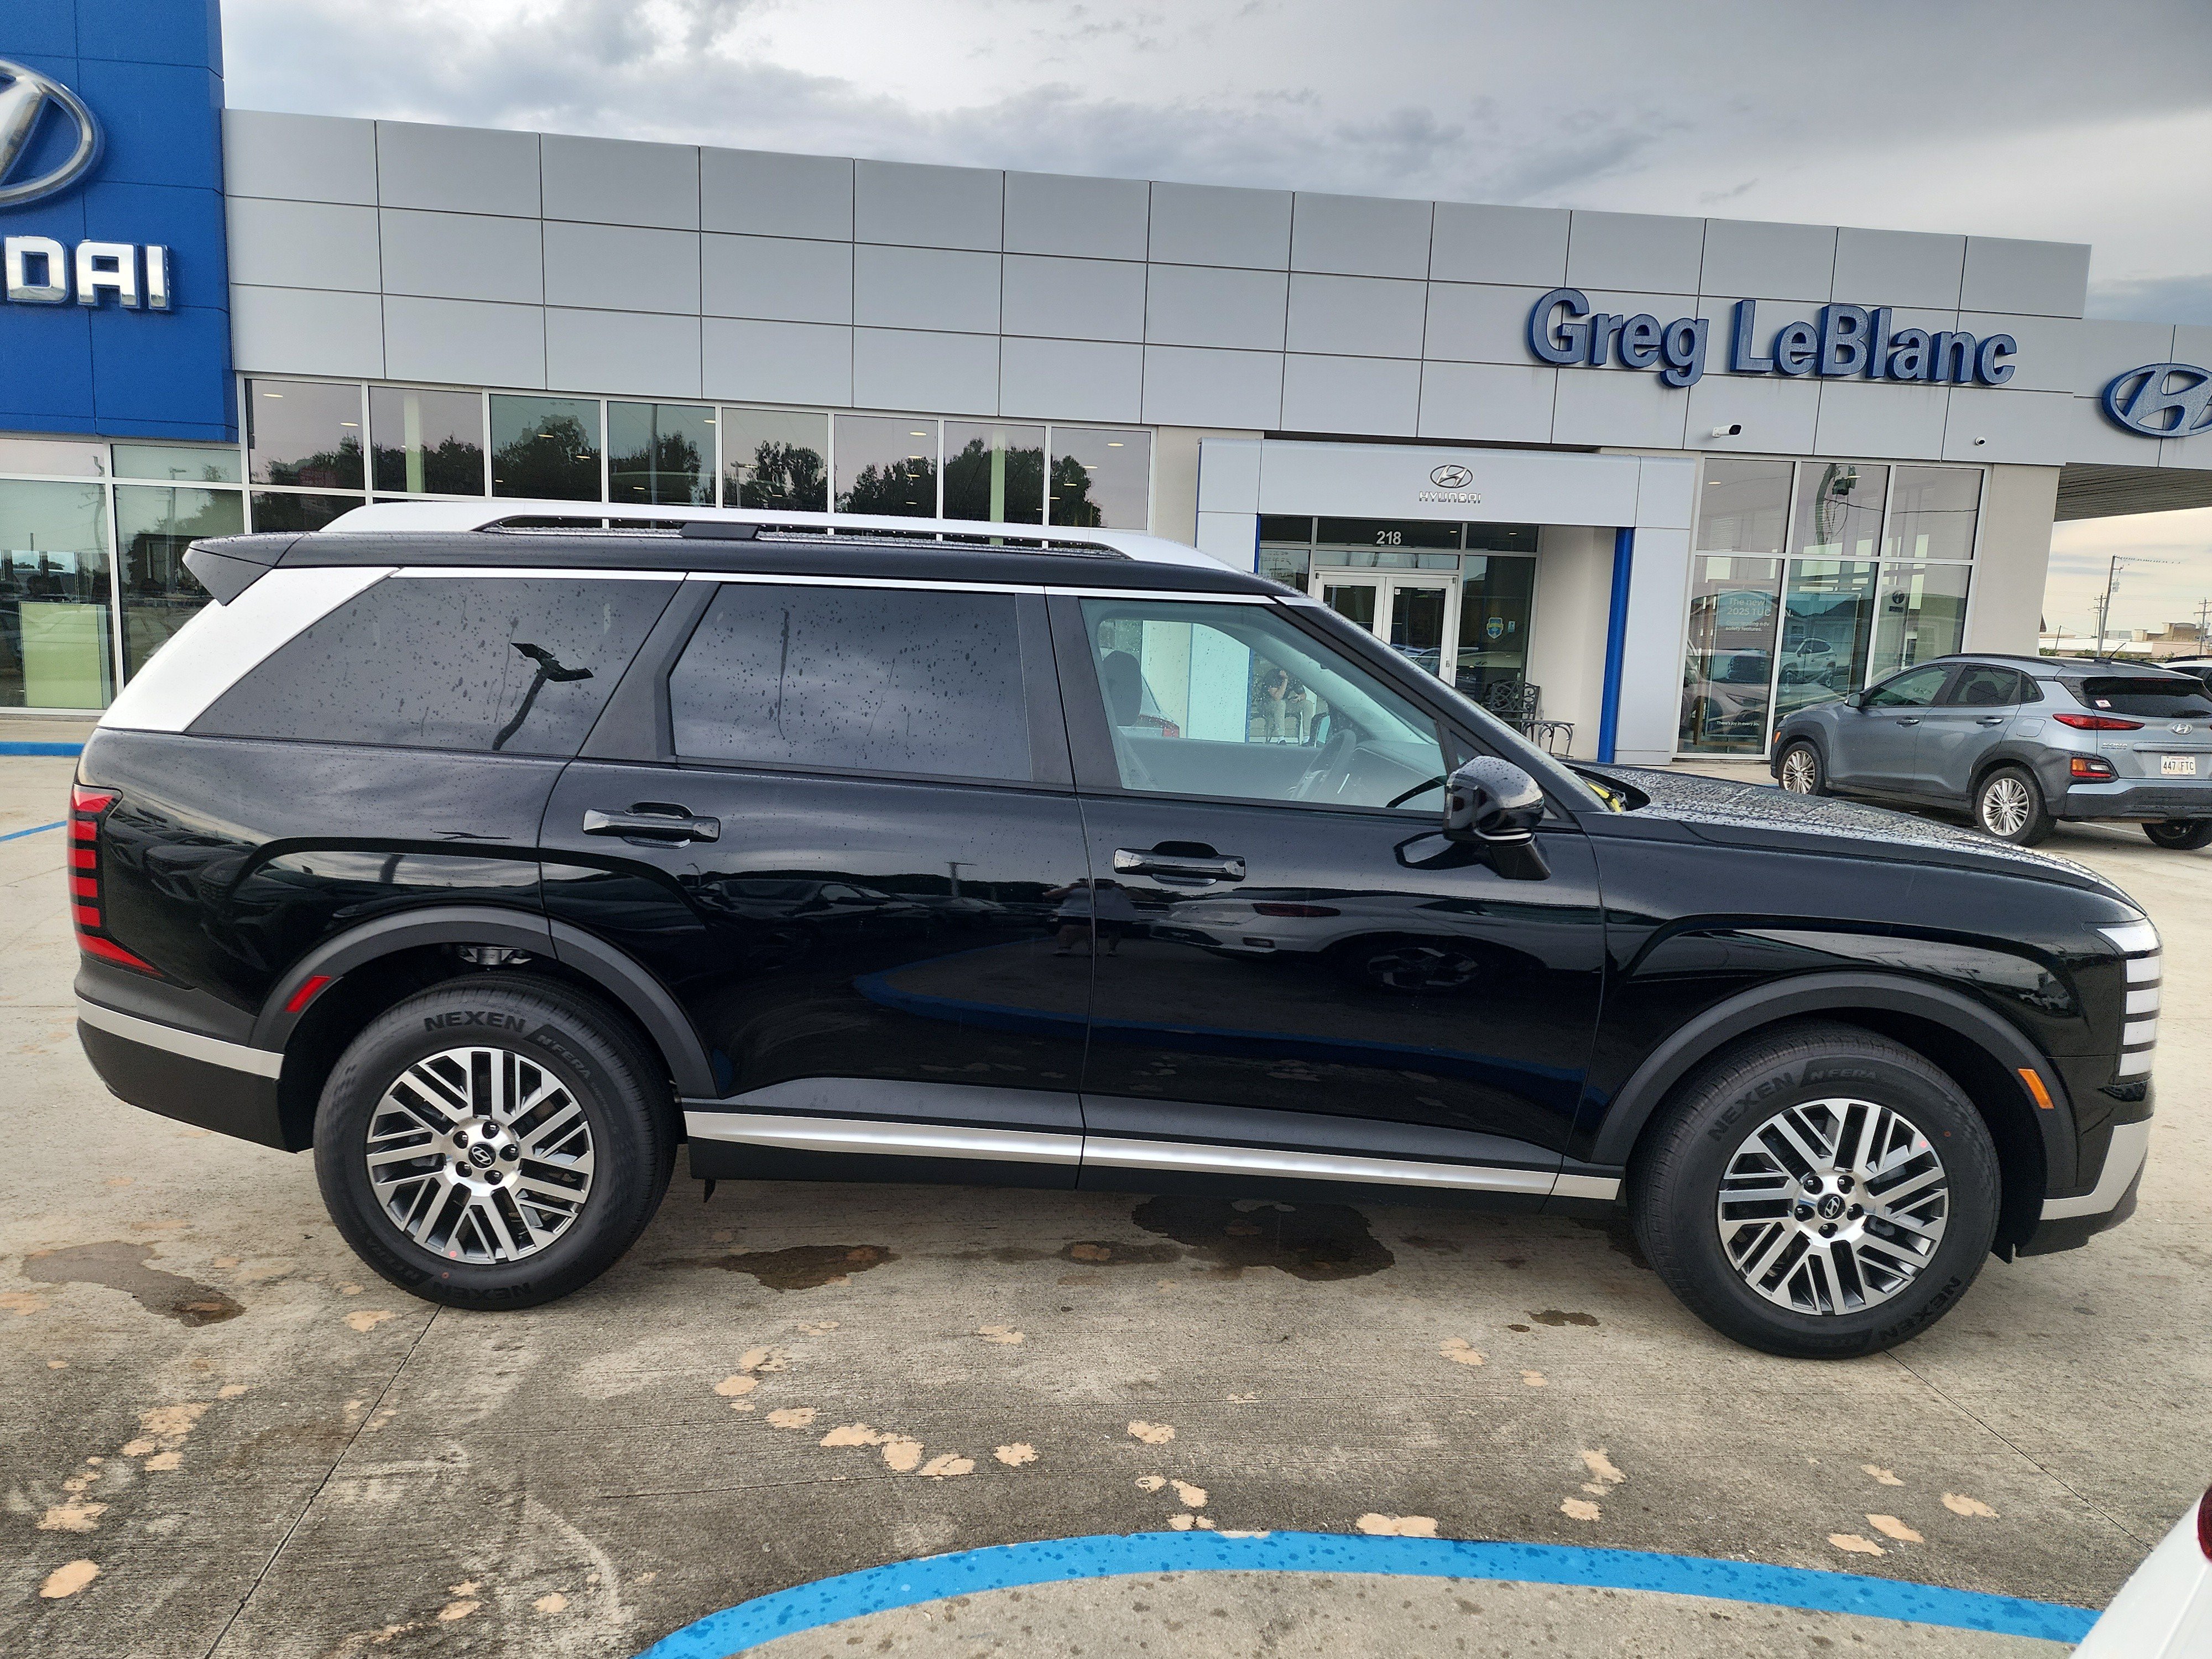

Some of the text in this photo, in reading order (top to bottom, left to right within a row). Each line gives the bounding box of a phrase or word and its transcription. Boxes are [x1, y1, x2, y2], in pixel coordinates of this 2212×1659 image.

[1528, 288, 2017, 388] Greg LeBlanc
[1419, 491, 1481, 504] HYUNDAI
[1376, 531, 1401, 545] 218
[1729, 598, 1744, 606] The
[1727, 607, 1750, 615] 2025
[2163, 761, 2194, 770] 447 FTC
[424, 1010, 526, 1032] NEXEN
[1707, 1072, 1796, 1141] NEXEN
[431, 1281, 532, 1301] NEXEN
[1878, 1275, 1962, 1342] NEXEN
